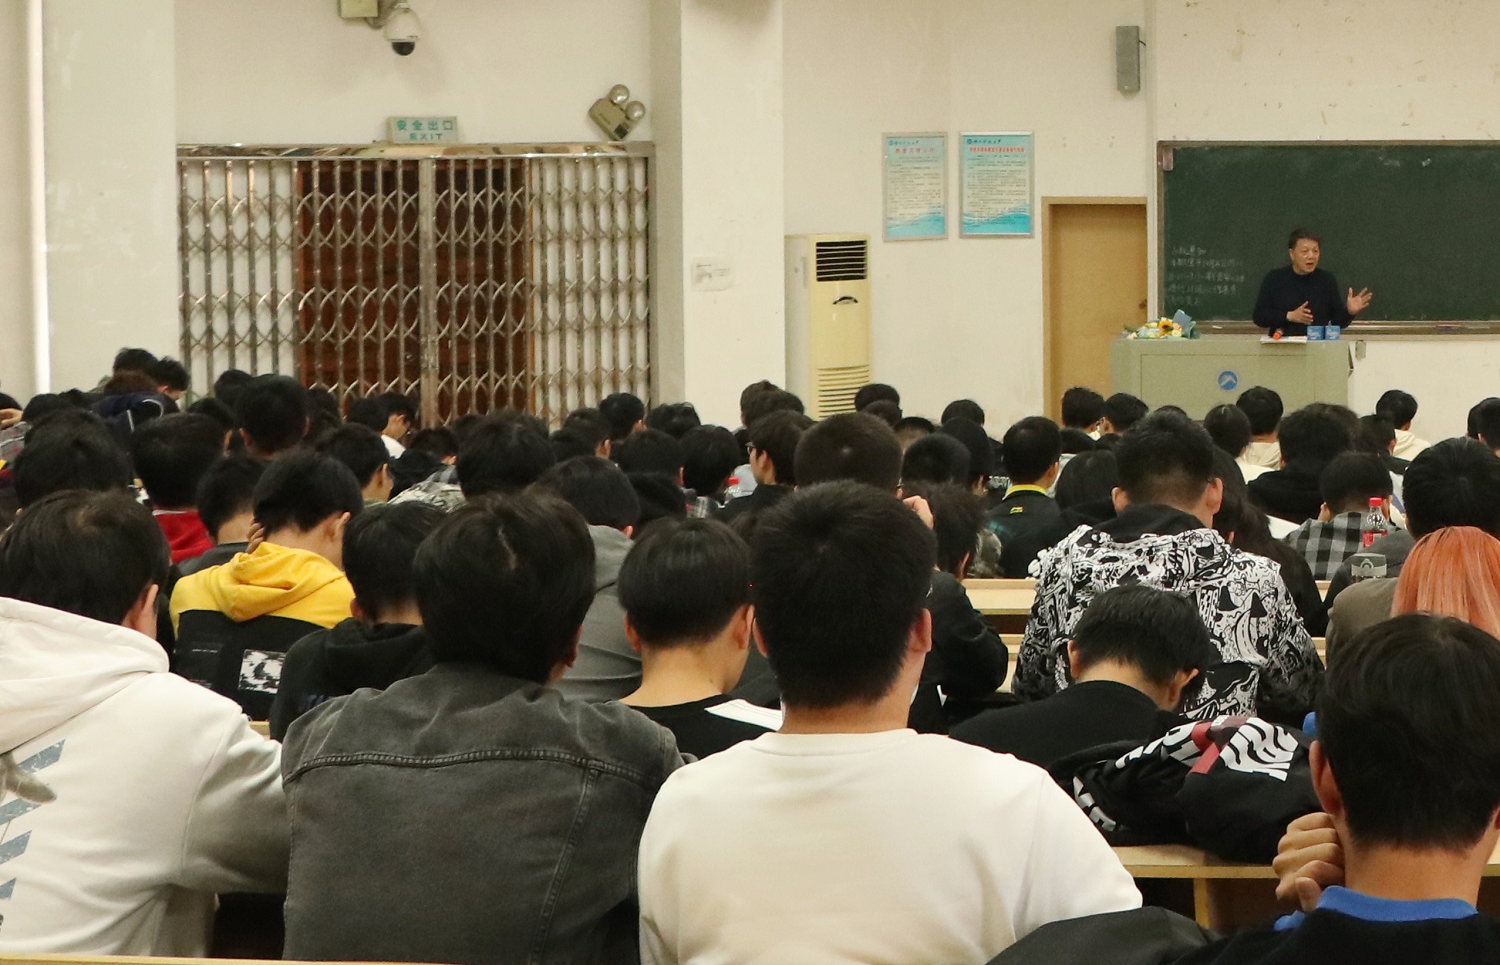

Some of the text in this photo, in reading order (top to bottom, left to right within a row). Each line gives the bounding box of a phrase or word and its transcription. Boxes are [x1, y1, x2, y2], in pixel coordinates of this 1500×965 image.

[396, 119, 453, 131] 安全出口
[409, 132, 443, 140] EXIT
